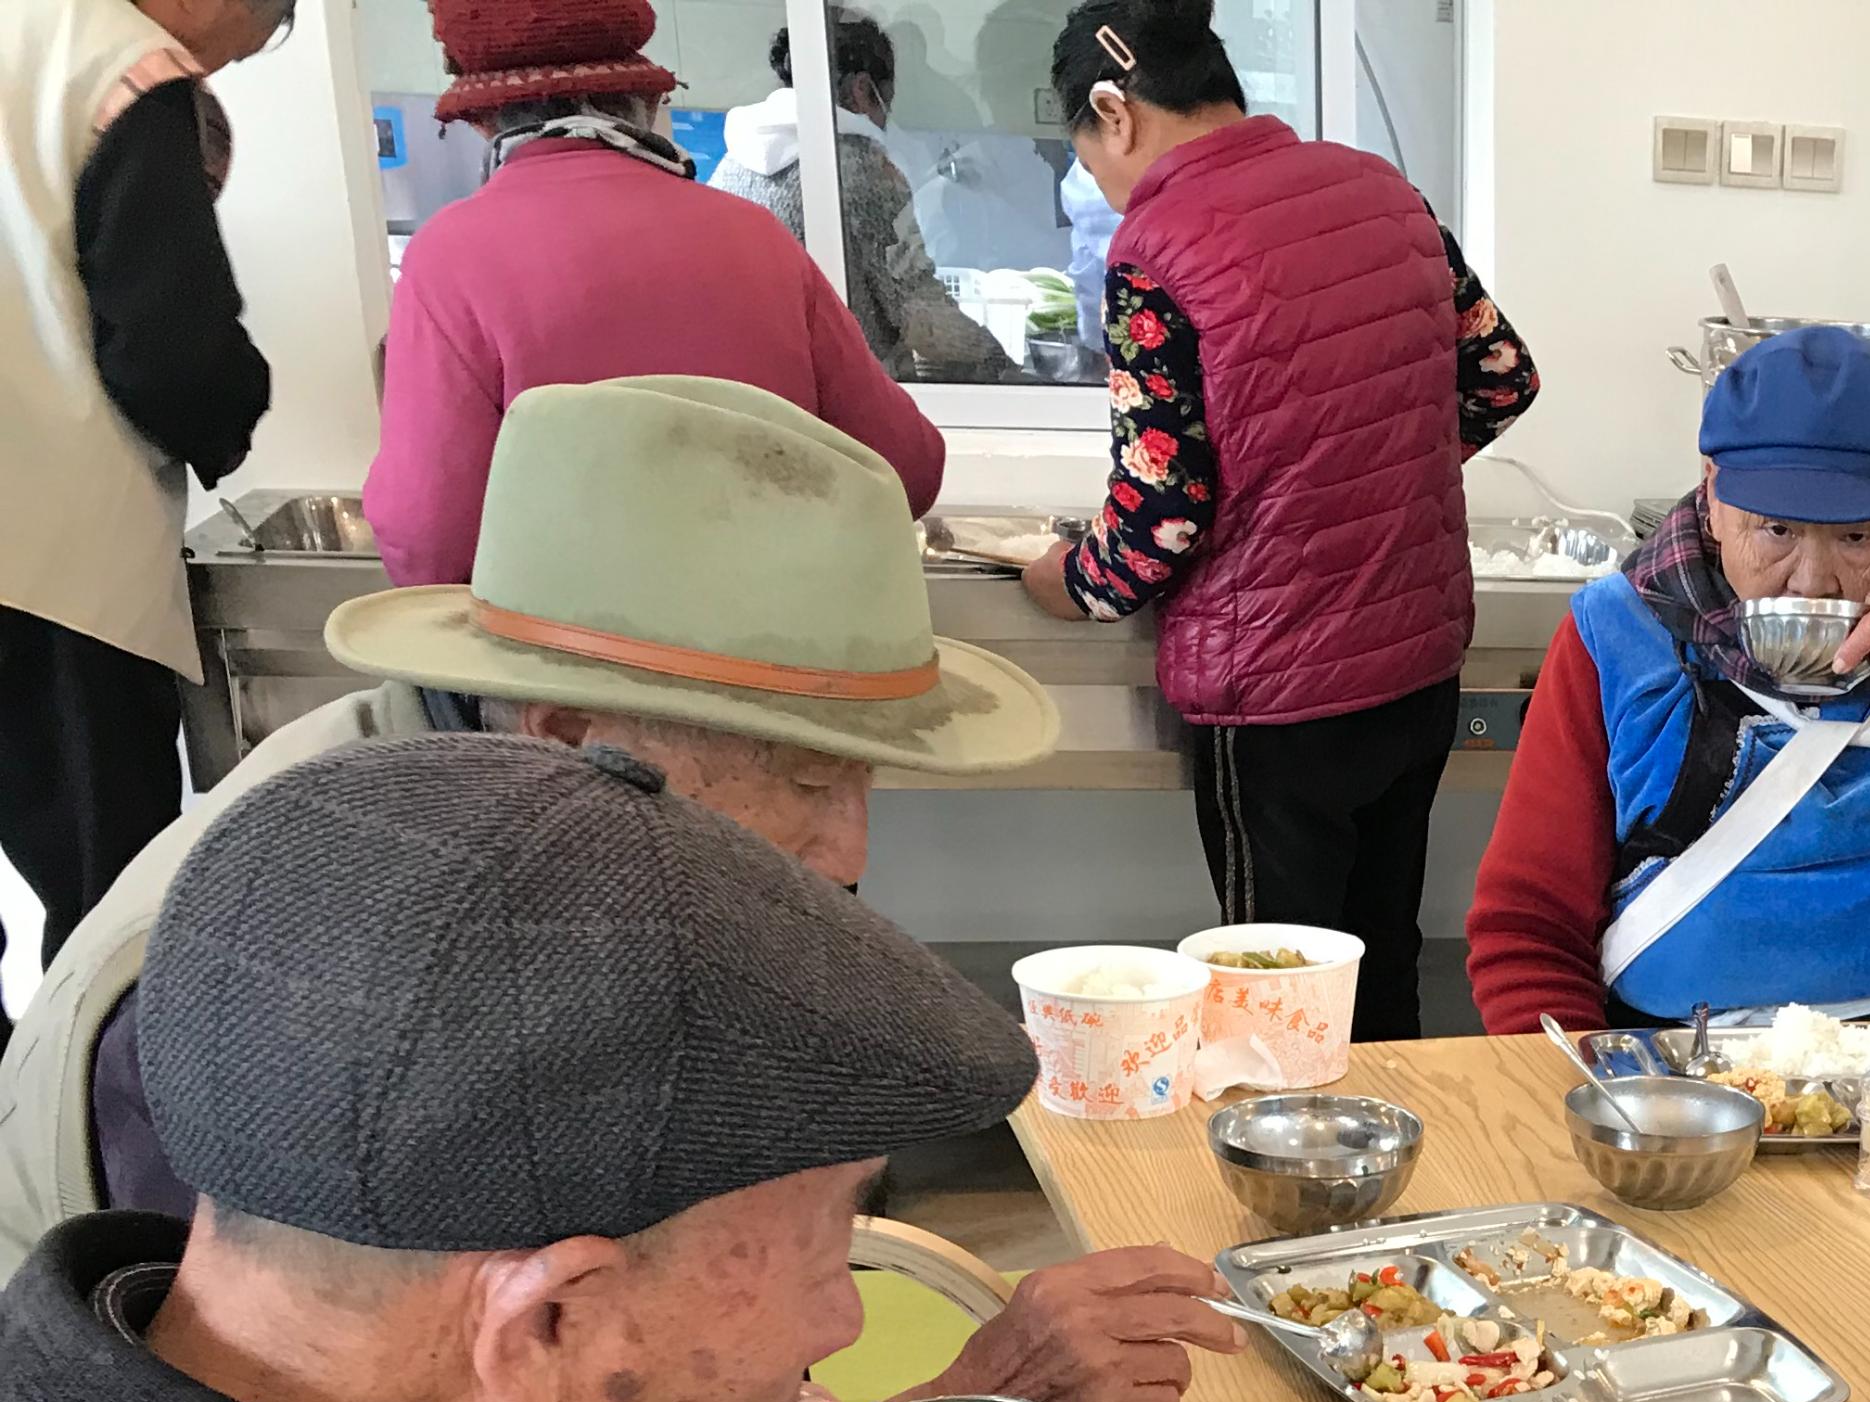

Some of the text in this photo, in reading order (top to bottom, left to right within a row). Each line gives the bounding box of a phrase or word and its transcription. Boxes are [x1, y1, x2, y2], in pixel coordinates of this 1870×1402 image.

[1206, 978, 1329, 1044] 店美味食品
